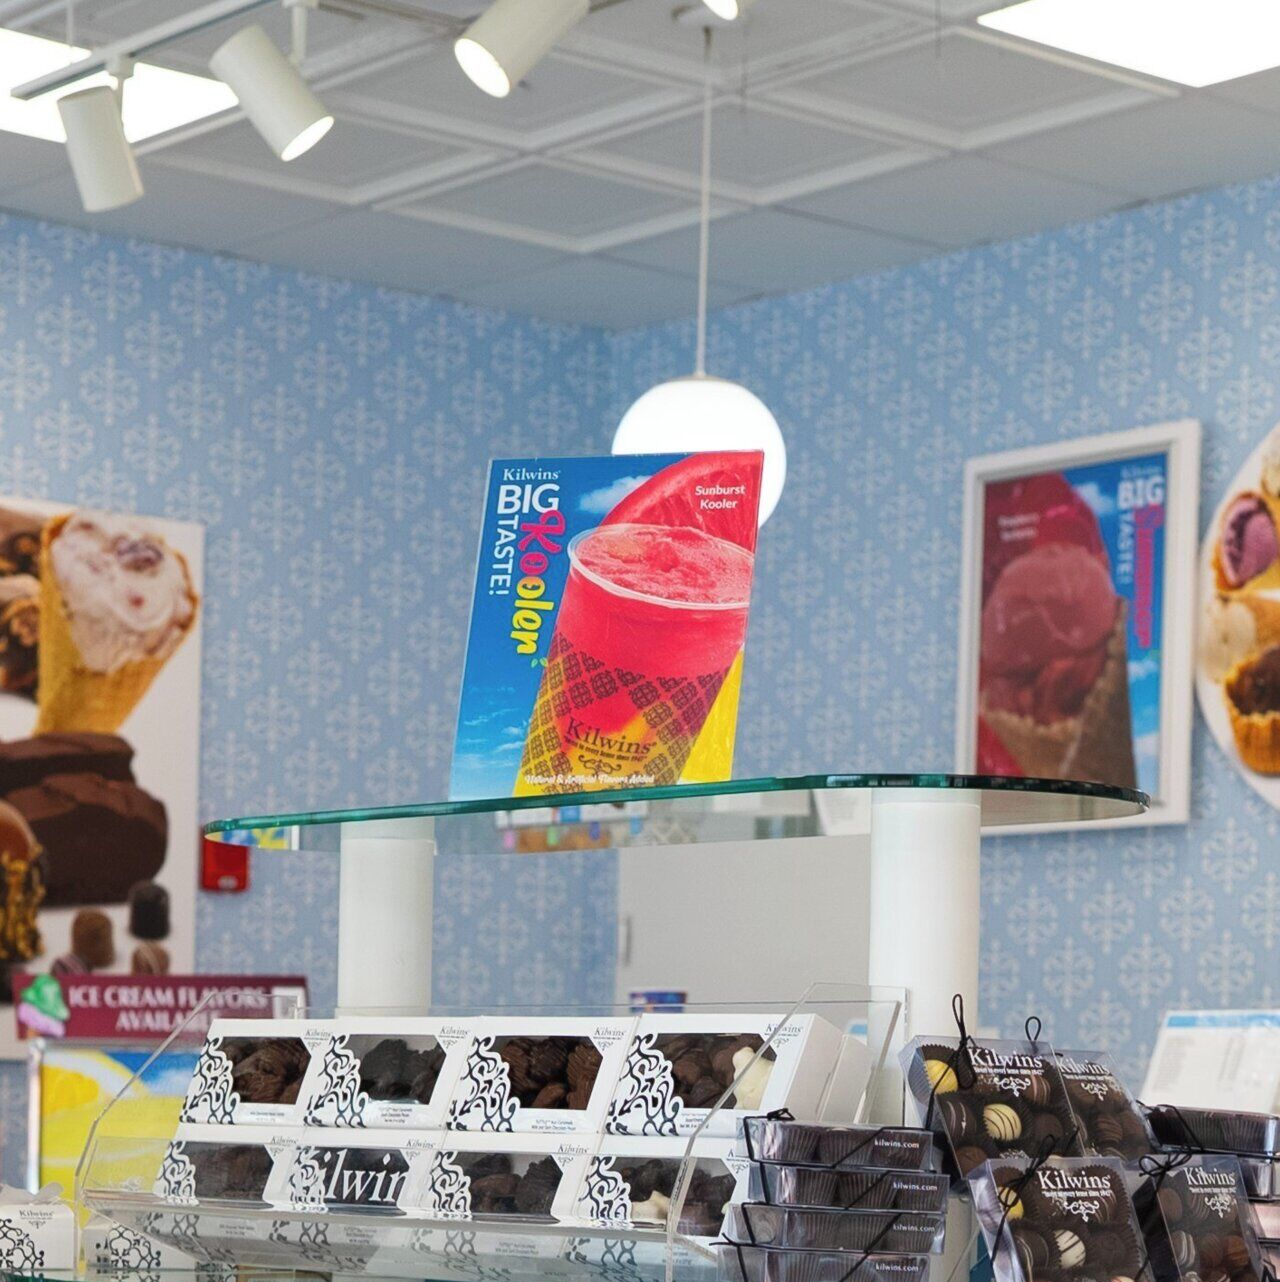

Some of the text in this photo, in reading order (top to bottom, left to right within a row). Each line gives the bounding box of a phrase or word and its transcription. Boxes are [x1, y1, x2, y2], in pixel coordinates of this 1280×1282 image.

[502, 467, 559, 481] Kilwins
[497, 483, 560, 515] BIG
[694, 484, 747, 497] Sunburst
[1118, 474, 1165, 509] BIG
[699, 498, 739, 511] Kooler
[488, 513, 520, 597] TASTE!
[510, 509, 566, 655] Kooler
[566, 717, 651, 754] Kilwins
[68, 985, 268, 1010] ICE CREAM FLAVORS
[968, 1048, 1043, 1069] Kilwins
[1056, 1057, 1111, 1076] Kilwins
[873, 1138, 920, 1149] kilwins.com
[1037, 1169, 1111, 1190] Kilwins
[1183, 1166, 1236, 1186] Kilwins
[892, 1182, 938, 1192] kilwins.com
[892, 1223, 936, 1233] kilwins.com
[875, 1263, 919, 1273] kilwins.com
